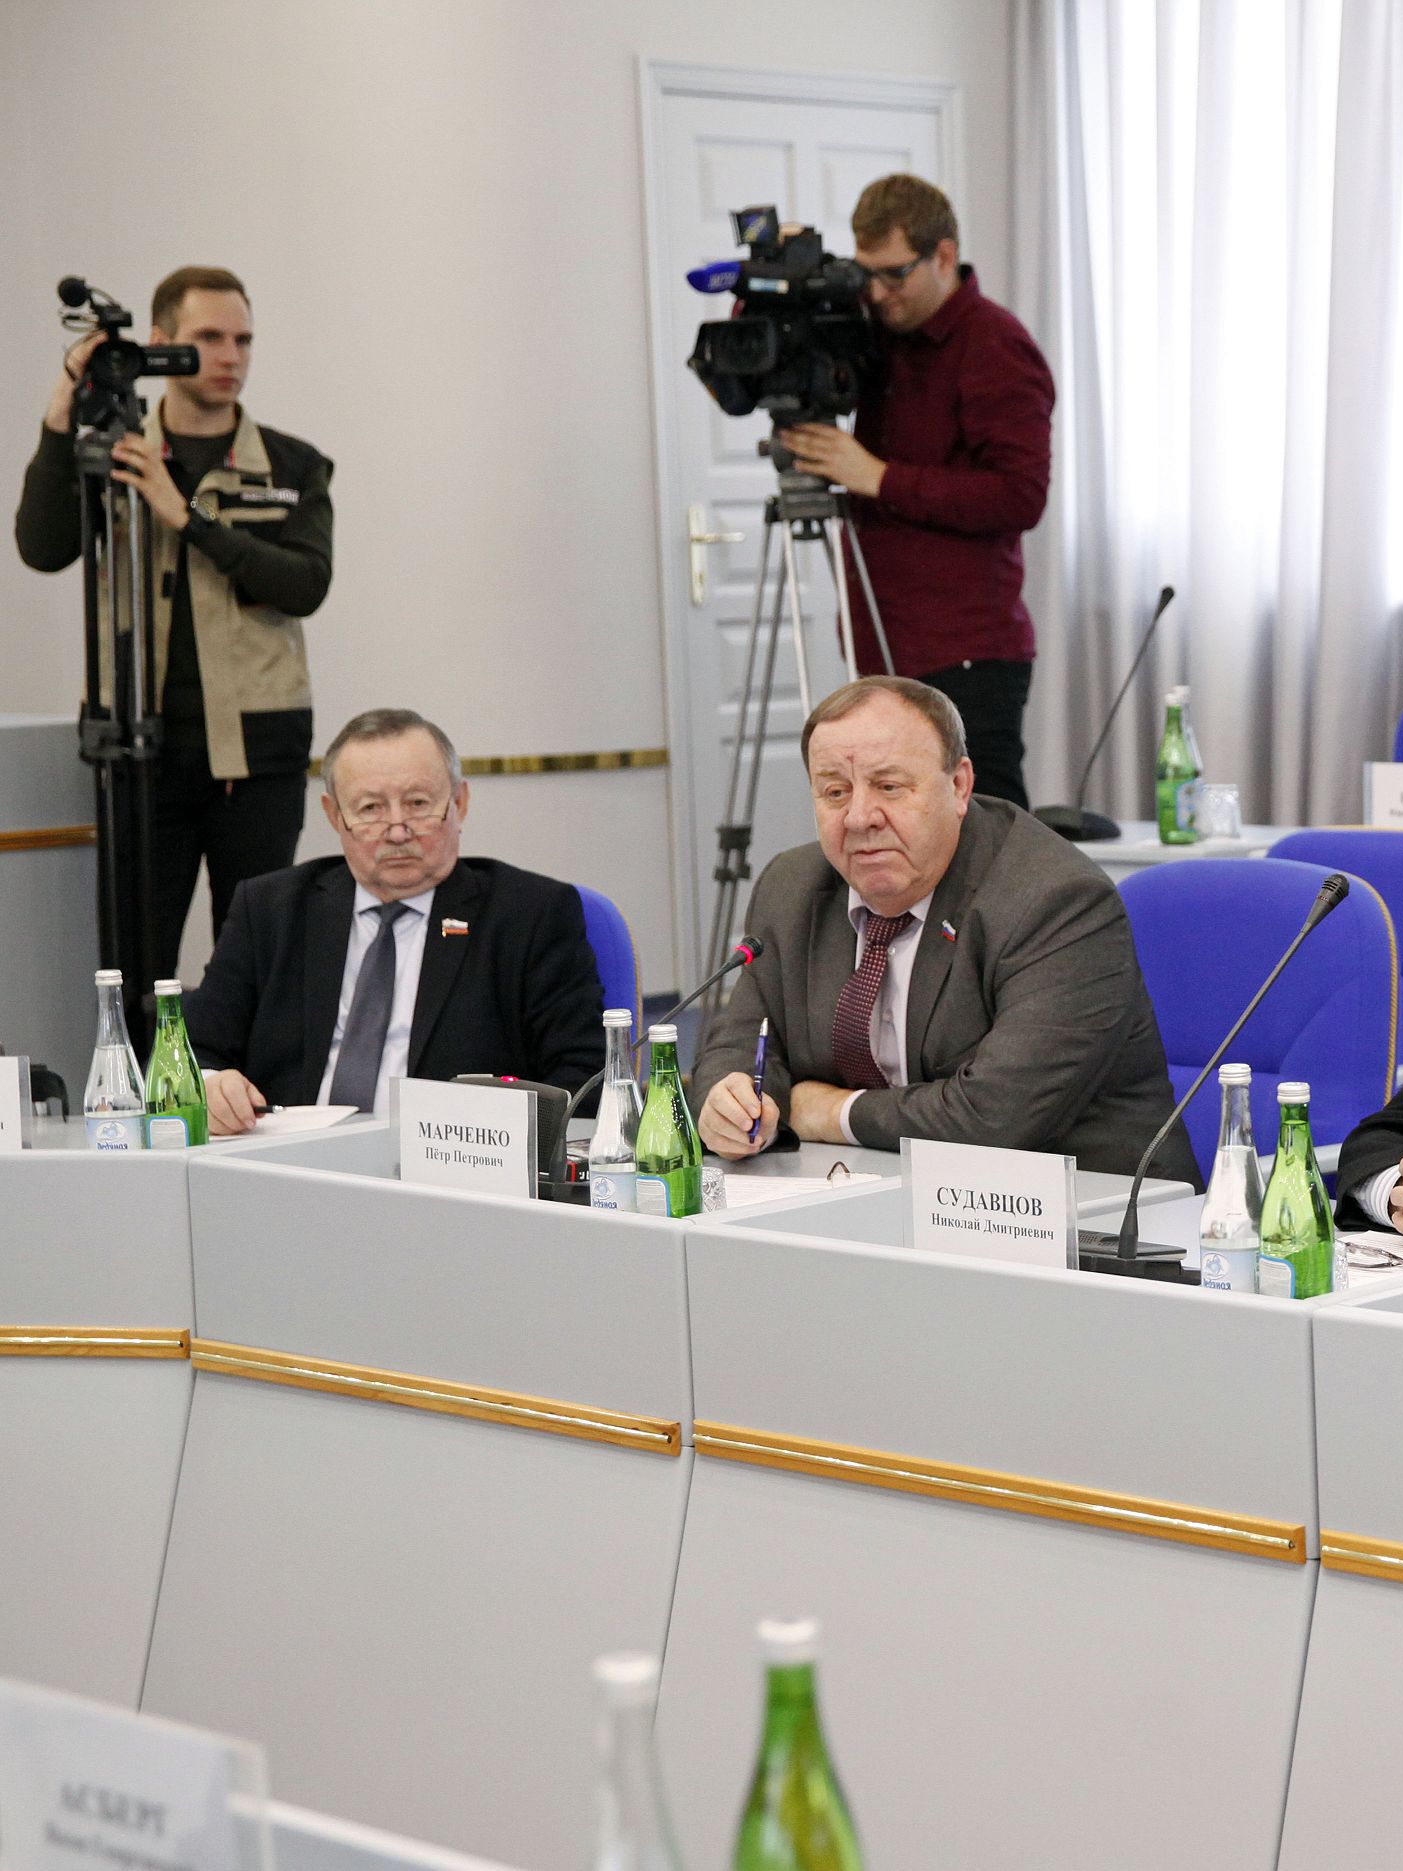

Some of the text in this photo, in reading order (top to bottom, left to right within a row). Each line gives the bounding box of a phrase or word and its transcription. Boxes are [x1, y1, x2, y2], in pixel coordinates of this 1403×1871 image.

[418, 1121, 510, 1147] МАРЧЕНКО
[425, 1146, 503, 1168] Пётр Петрович
[936, 1186, 1043, 1217] СУДАВЦОВ
[931, 1212, 1054, 1240] Николай Дмитриевич
